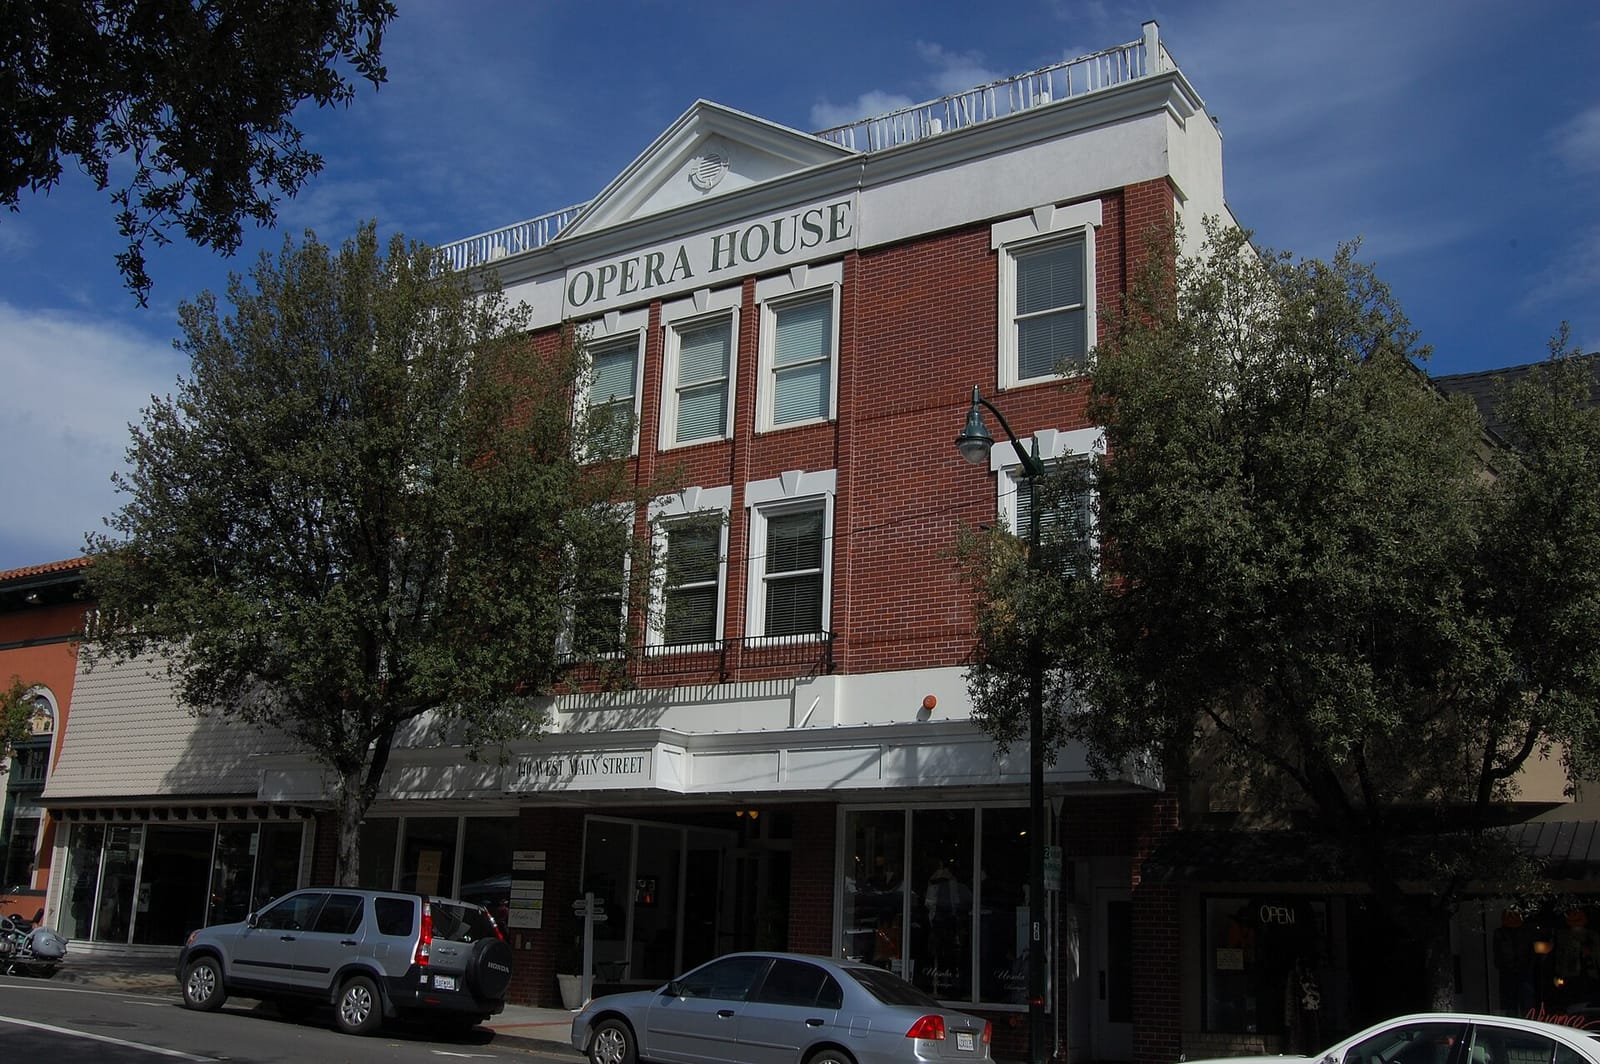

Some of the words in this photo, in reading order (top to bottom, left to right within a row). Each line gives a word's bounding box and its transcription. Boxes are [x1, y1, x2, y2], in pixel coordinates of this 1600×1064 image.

[567, 244, 694, 307] OPERA
[708, 200, 853, 273] HOUSE
[535, 758, 565, 777] WEST
[569, 756, 599, 777] MAIN
[602, 756, 645, 775] STREET
[1260, 904, 1295, 924] OPEN
[487, 961, 510, 974] HONDA
